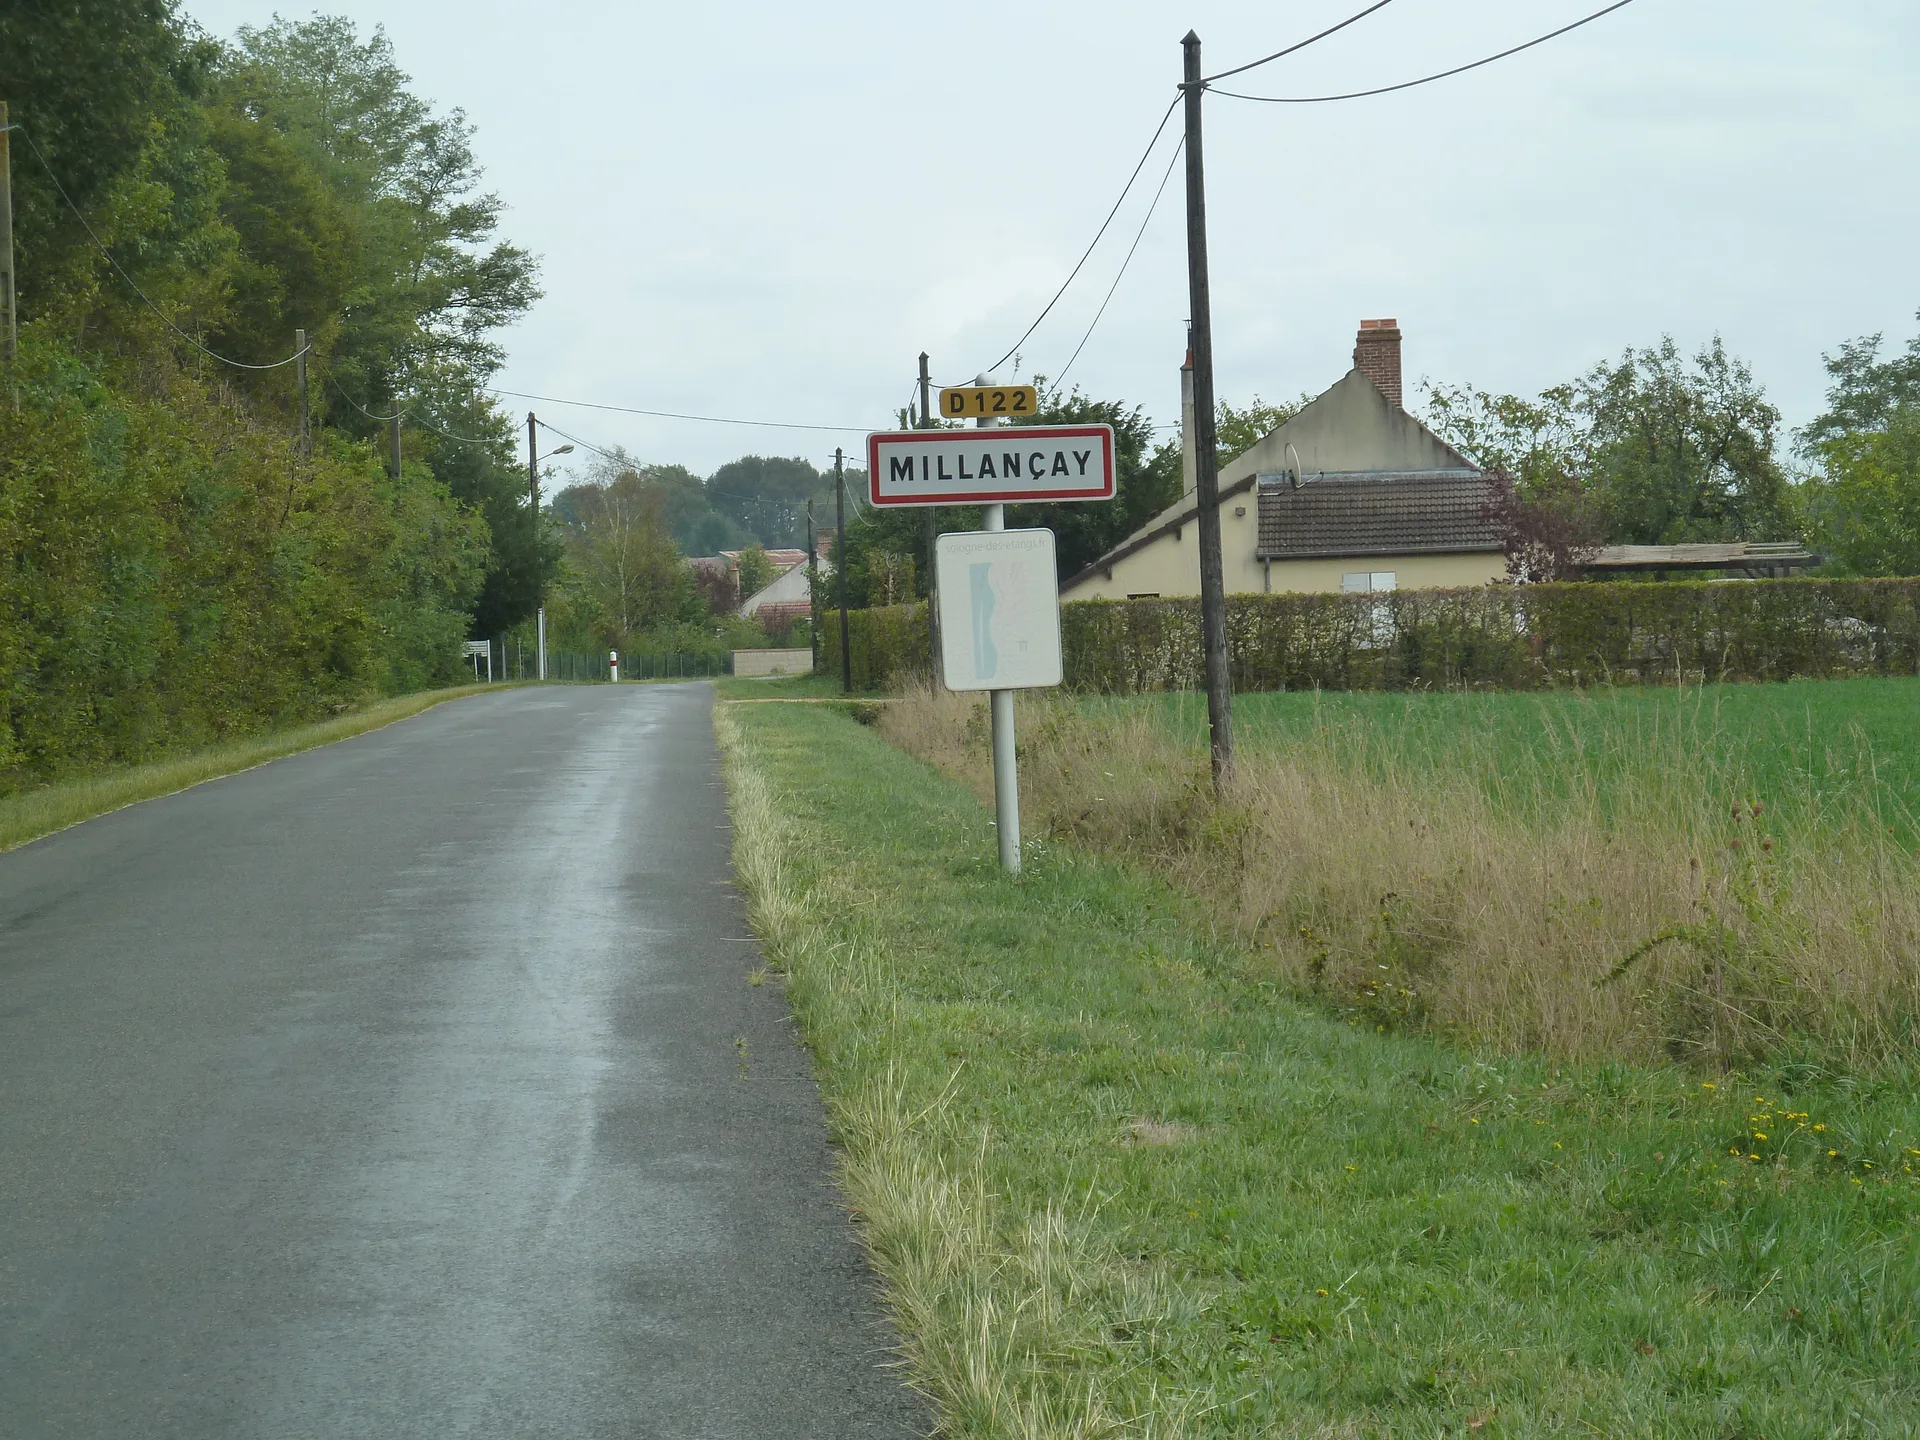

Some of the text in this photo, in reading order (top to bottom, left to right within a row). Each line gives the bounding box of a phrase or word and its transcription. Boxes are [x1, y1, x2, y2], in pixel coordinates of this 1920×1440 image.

[950, 390, 1027, 413] D 122
[890, 450, 1092, 482] MILLANÇAY
